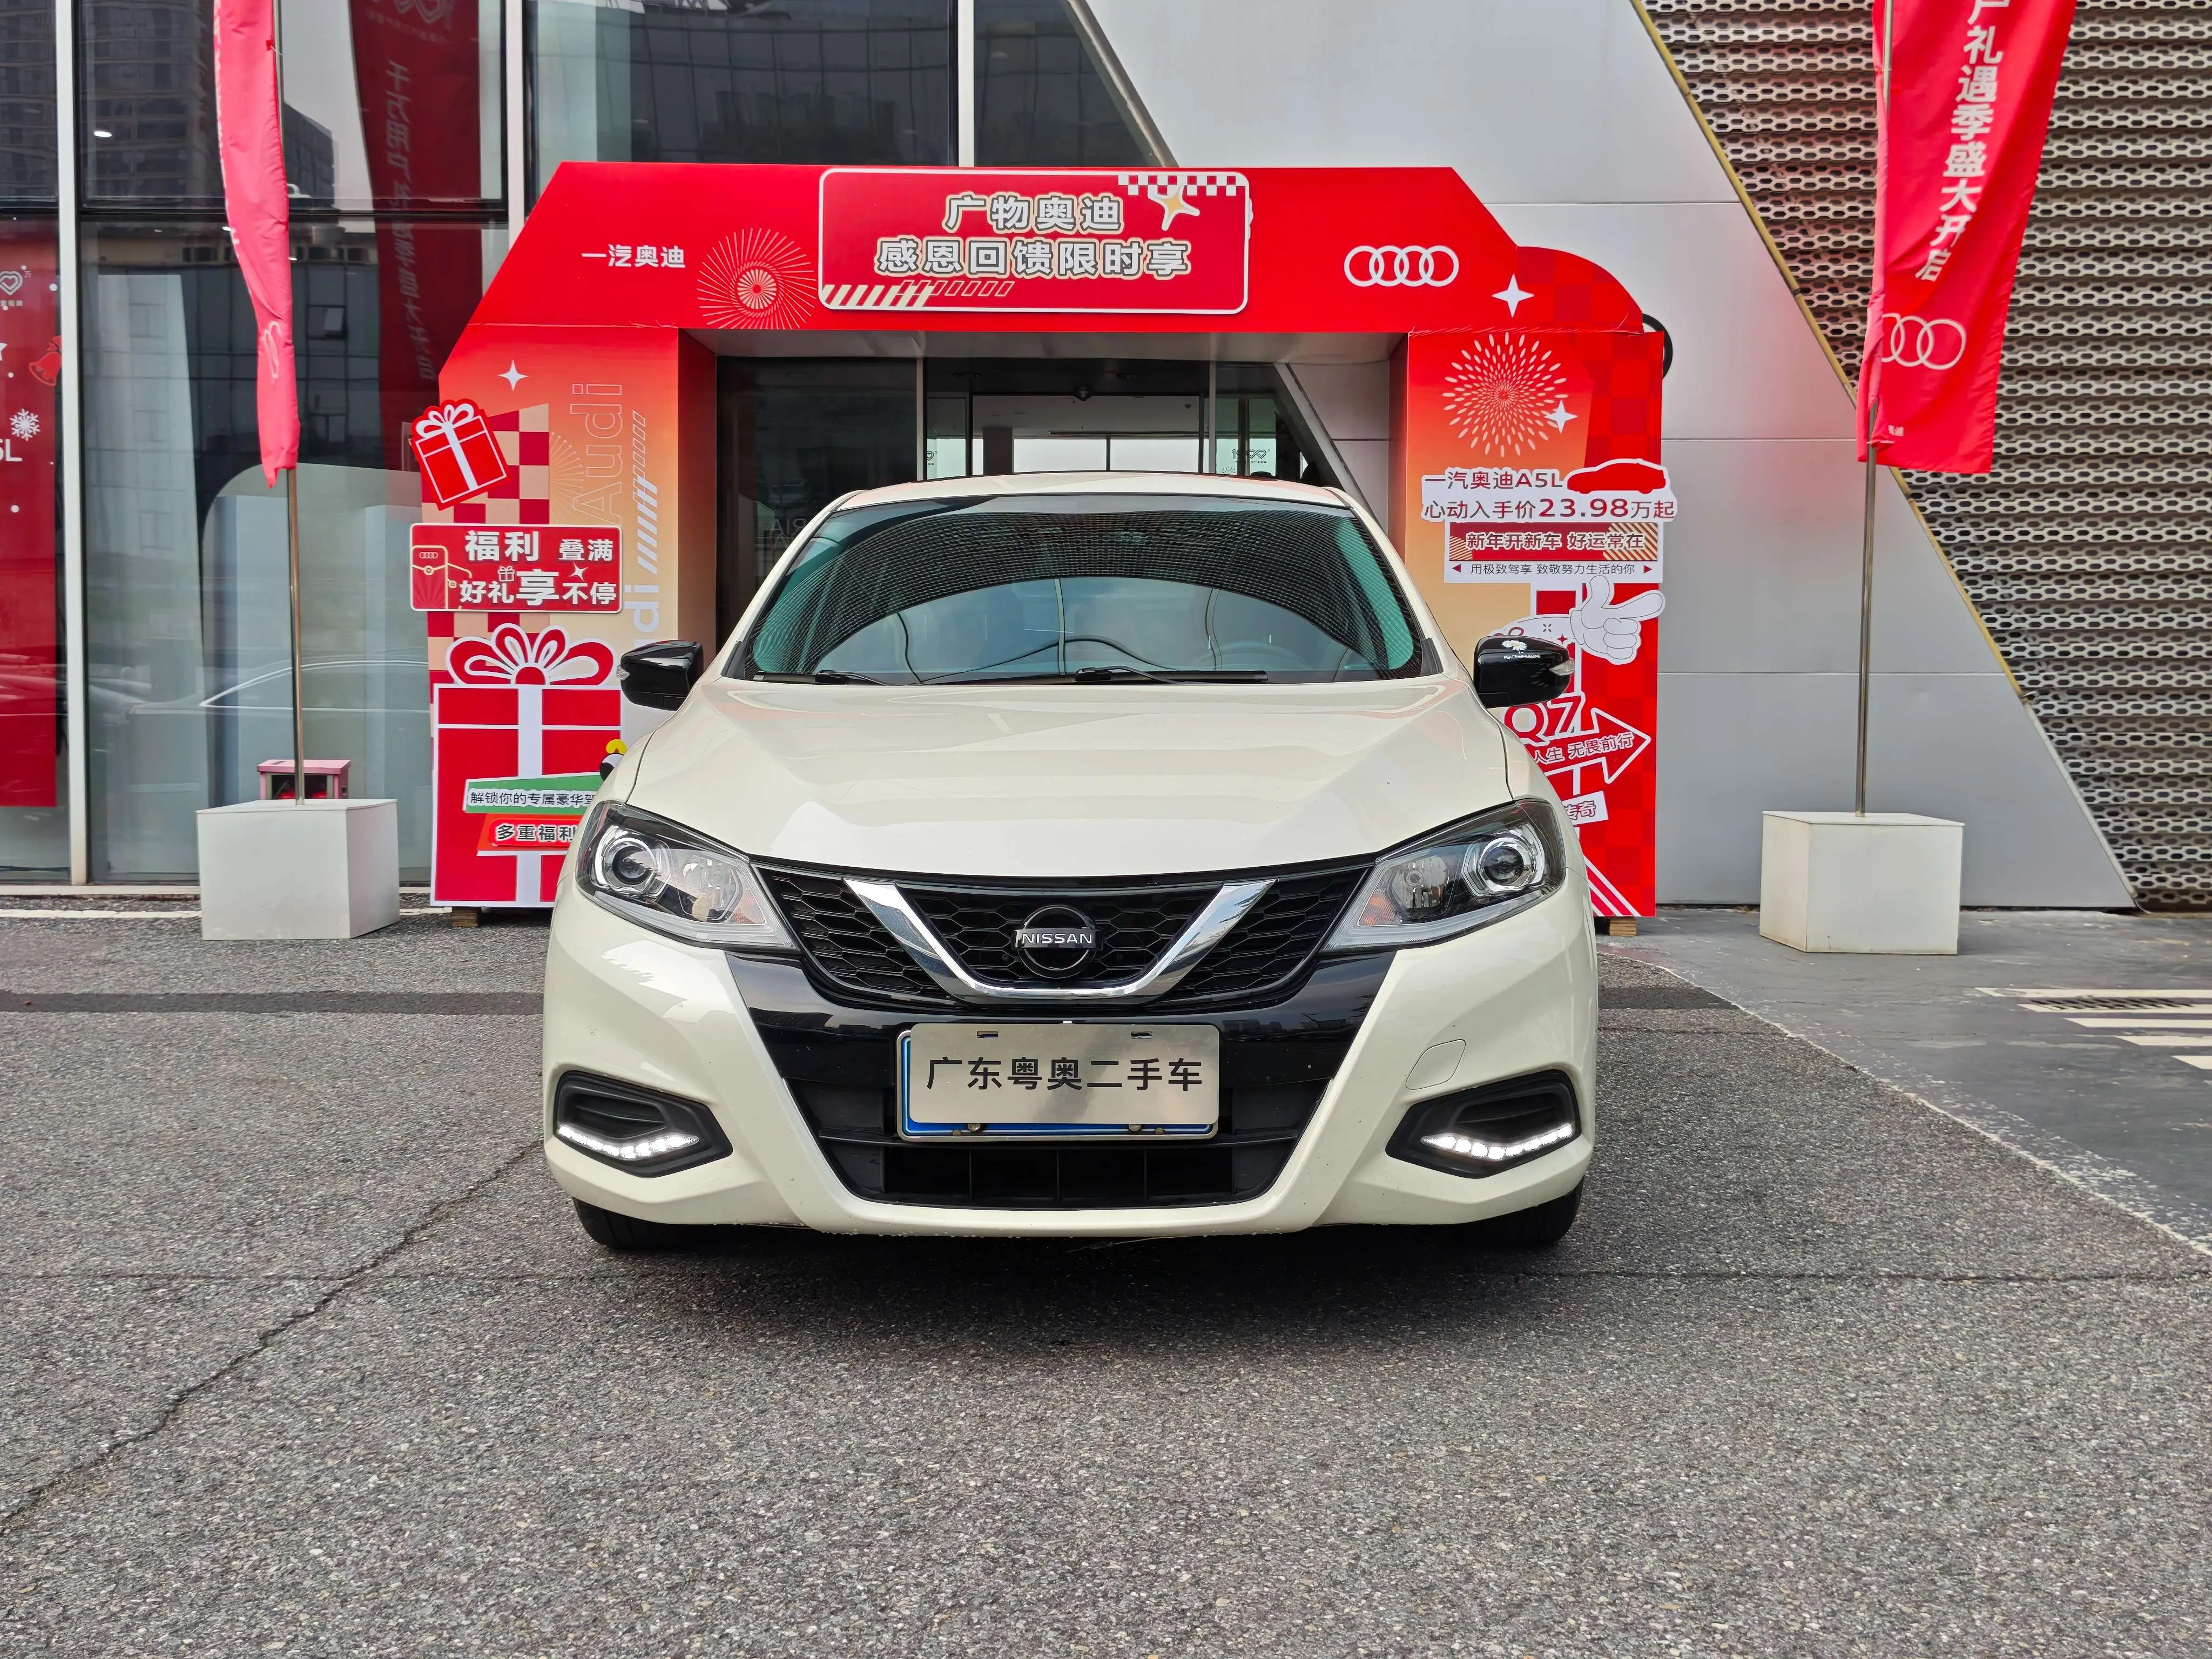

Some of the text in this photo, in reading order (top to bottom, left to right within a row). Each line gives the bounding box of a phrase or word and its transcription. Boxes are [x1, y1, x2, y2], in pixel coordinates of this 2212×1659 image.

[945, 195, 1123, 231] 广物奥迪
[581, 244, 686, 268] 一汽奥迪
[878, 240, 1190, 276] 感恩回馈限时享
[570, 383, 623, 526] Audi
[1425, 470, 1563, 489] 一汽奥迪A5L
[1424, 498, 1675, 519] 心动入手价23.98万起
[465, 531, 613, 562] 福利 叠满
[1466, 532, 1645, 550] 新年开新车 好运常在
[1471, 563, 1635, 575] 用极致驾享 致敬努力生活的你
[459, 569, 617, 605] 好礼享不停
[1505, 696, 1581, 741] Q7
[1568, 732, 1634, 757] 无畏前行
[1022, 933, 1093, 944] NISSAN
[927, 1057, 1202, 1091] 广东粤奥二手车
